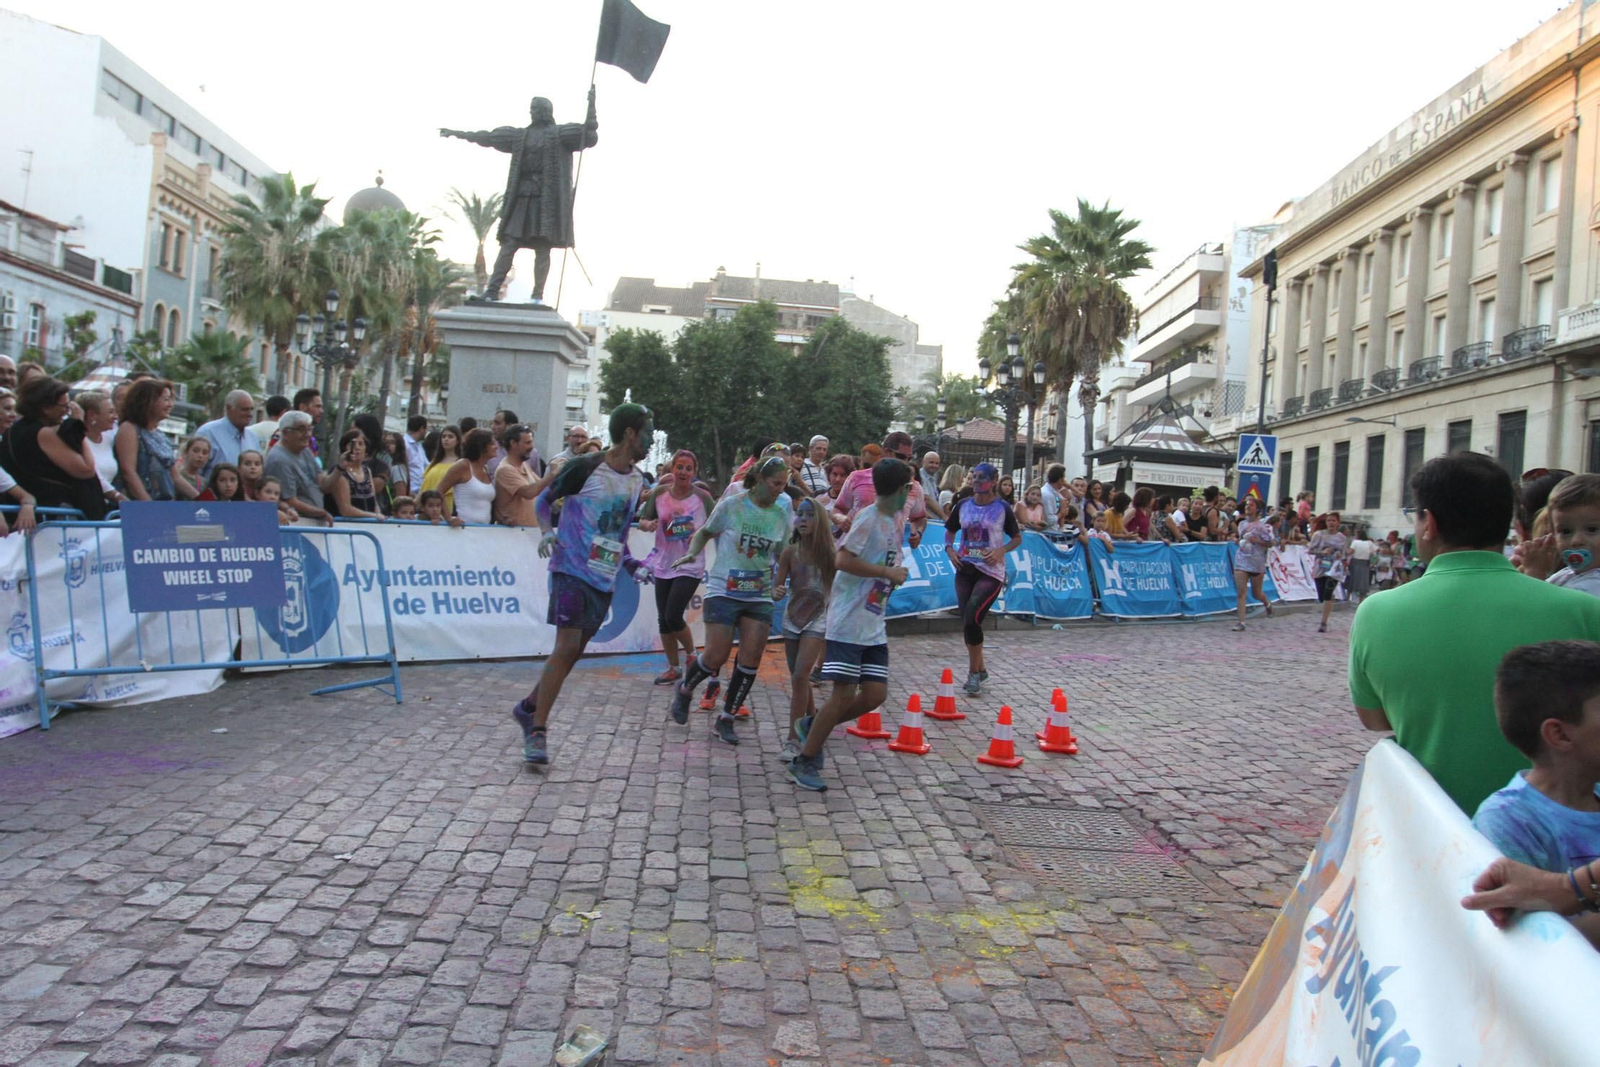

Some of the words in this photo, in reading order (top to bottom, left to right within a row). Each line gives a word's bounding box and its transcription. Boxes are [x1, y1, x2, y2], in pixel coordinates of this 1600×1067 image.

[1331, 157, 1382, 208] BANCO
[1389, 150, 1402, 168] DE
[481, 383, 518, 394] HUELVA
[739, 533, 773, 551] FEST
[133, 548, 195, 564] CAMBIO
[199, 547, 217, 562] DE
[221, 547, 275, 562] RUEDAS
[604, 551, 614, 561] 14
[163, 571, 213, 586] WHEEL
[217, 569, 253, 584] STOP
[342, 563, 516, 592] Ayuntamiento
[925, 561, 949, 577] DE
[737, 580, 755, 589] 298
[1137, 577, 1170, 590] HUELVA
[392, 592, 426, 615] de
[432, 591, 520, 615] Huelva
[41, 631, 86, 648] HUELA
